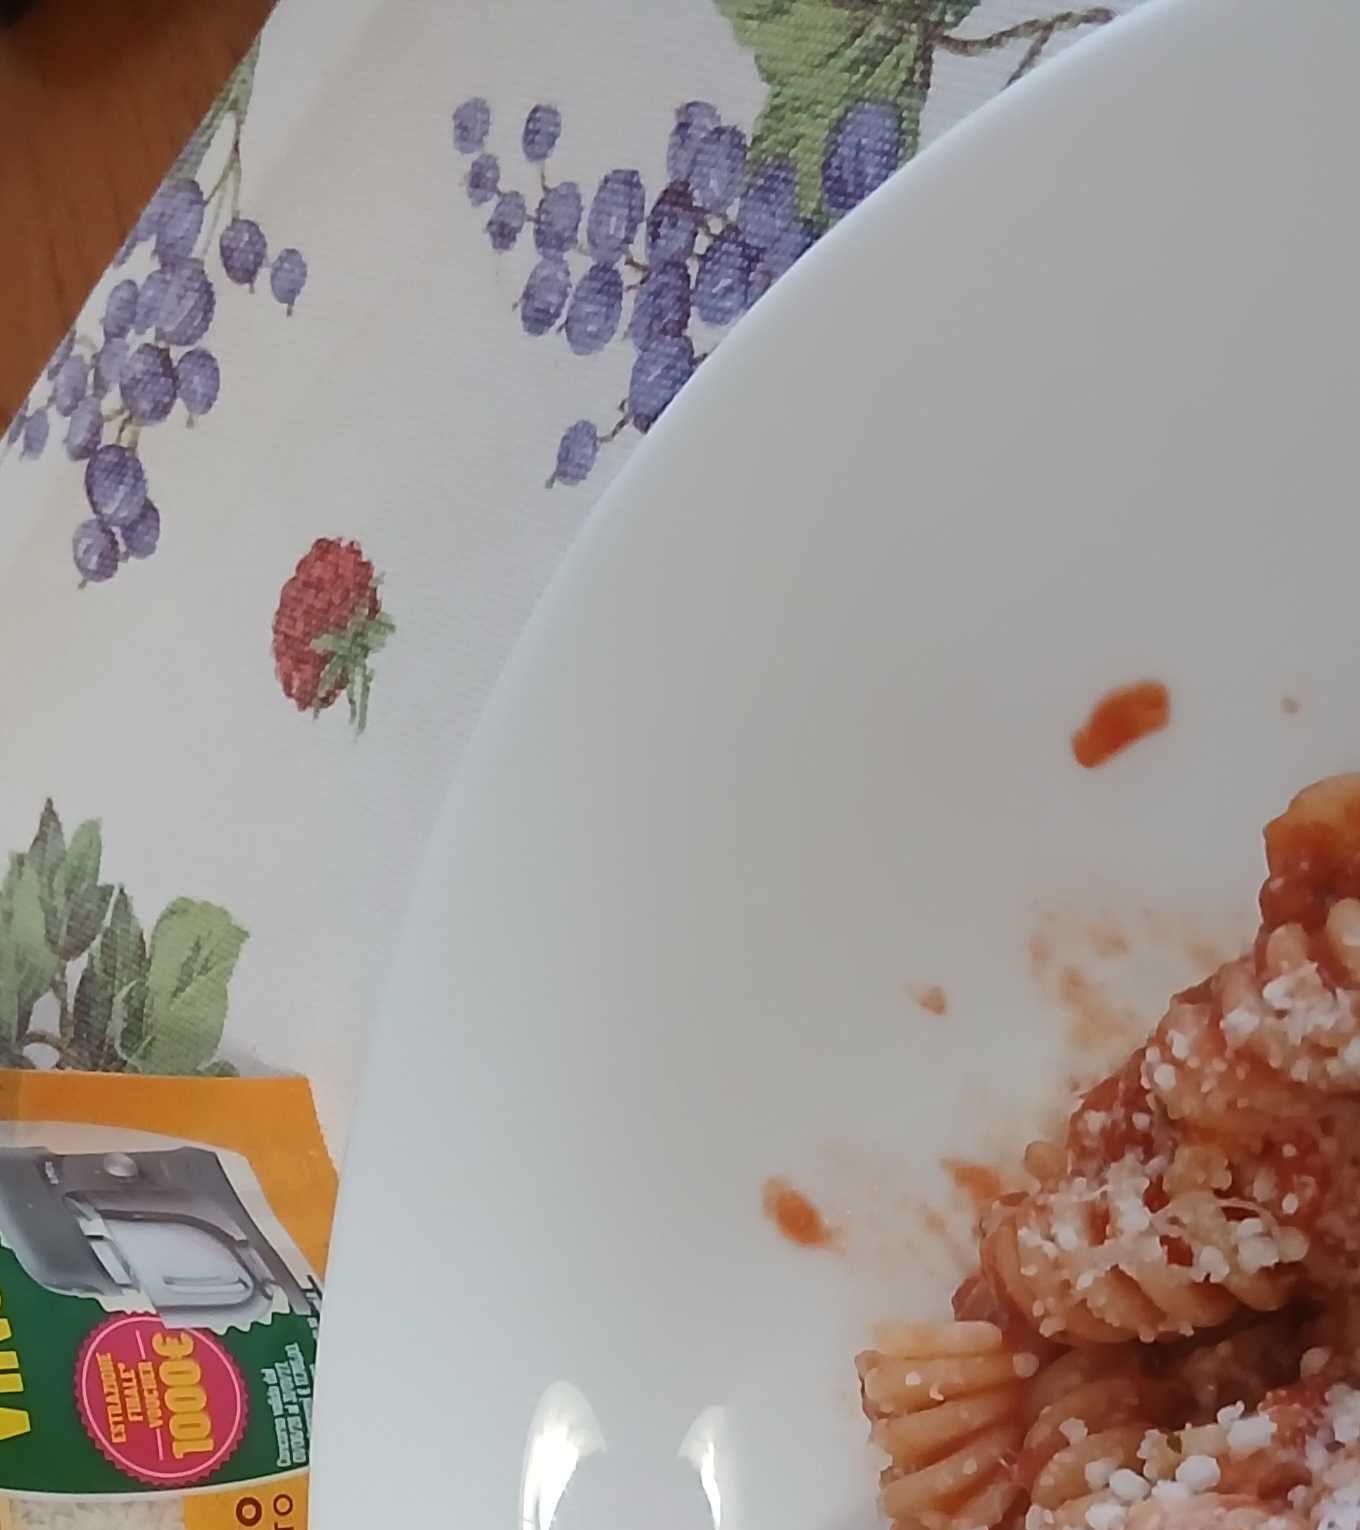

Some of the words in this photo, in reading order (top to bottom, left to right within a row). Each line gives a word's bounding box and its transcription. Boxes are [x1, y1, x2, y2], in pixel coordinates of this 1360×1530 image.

[95, 1352, 127, 1443] ESTRAZIONE
[137, 1361, 164, 1429] VOUCHER
[151, 1332, 215, 1459] 1000€
